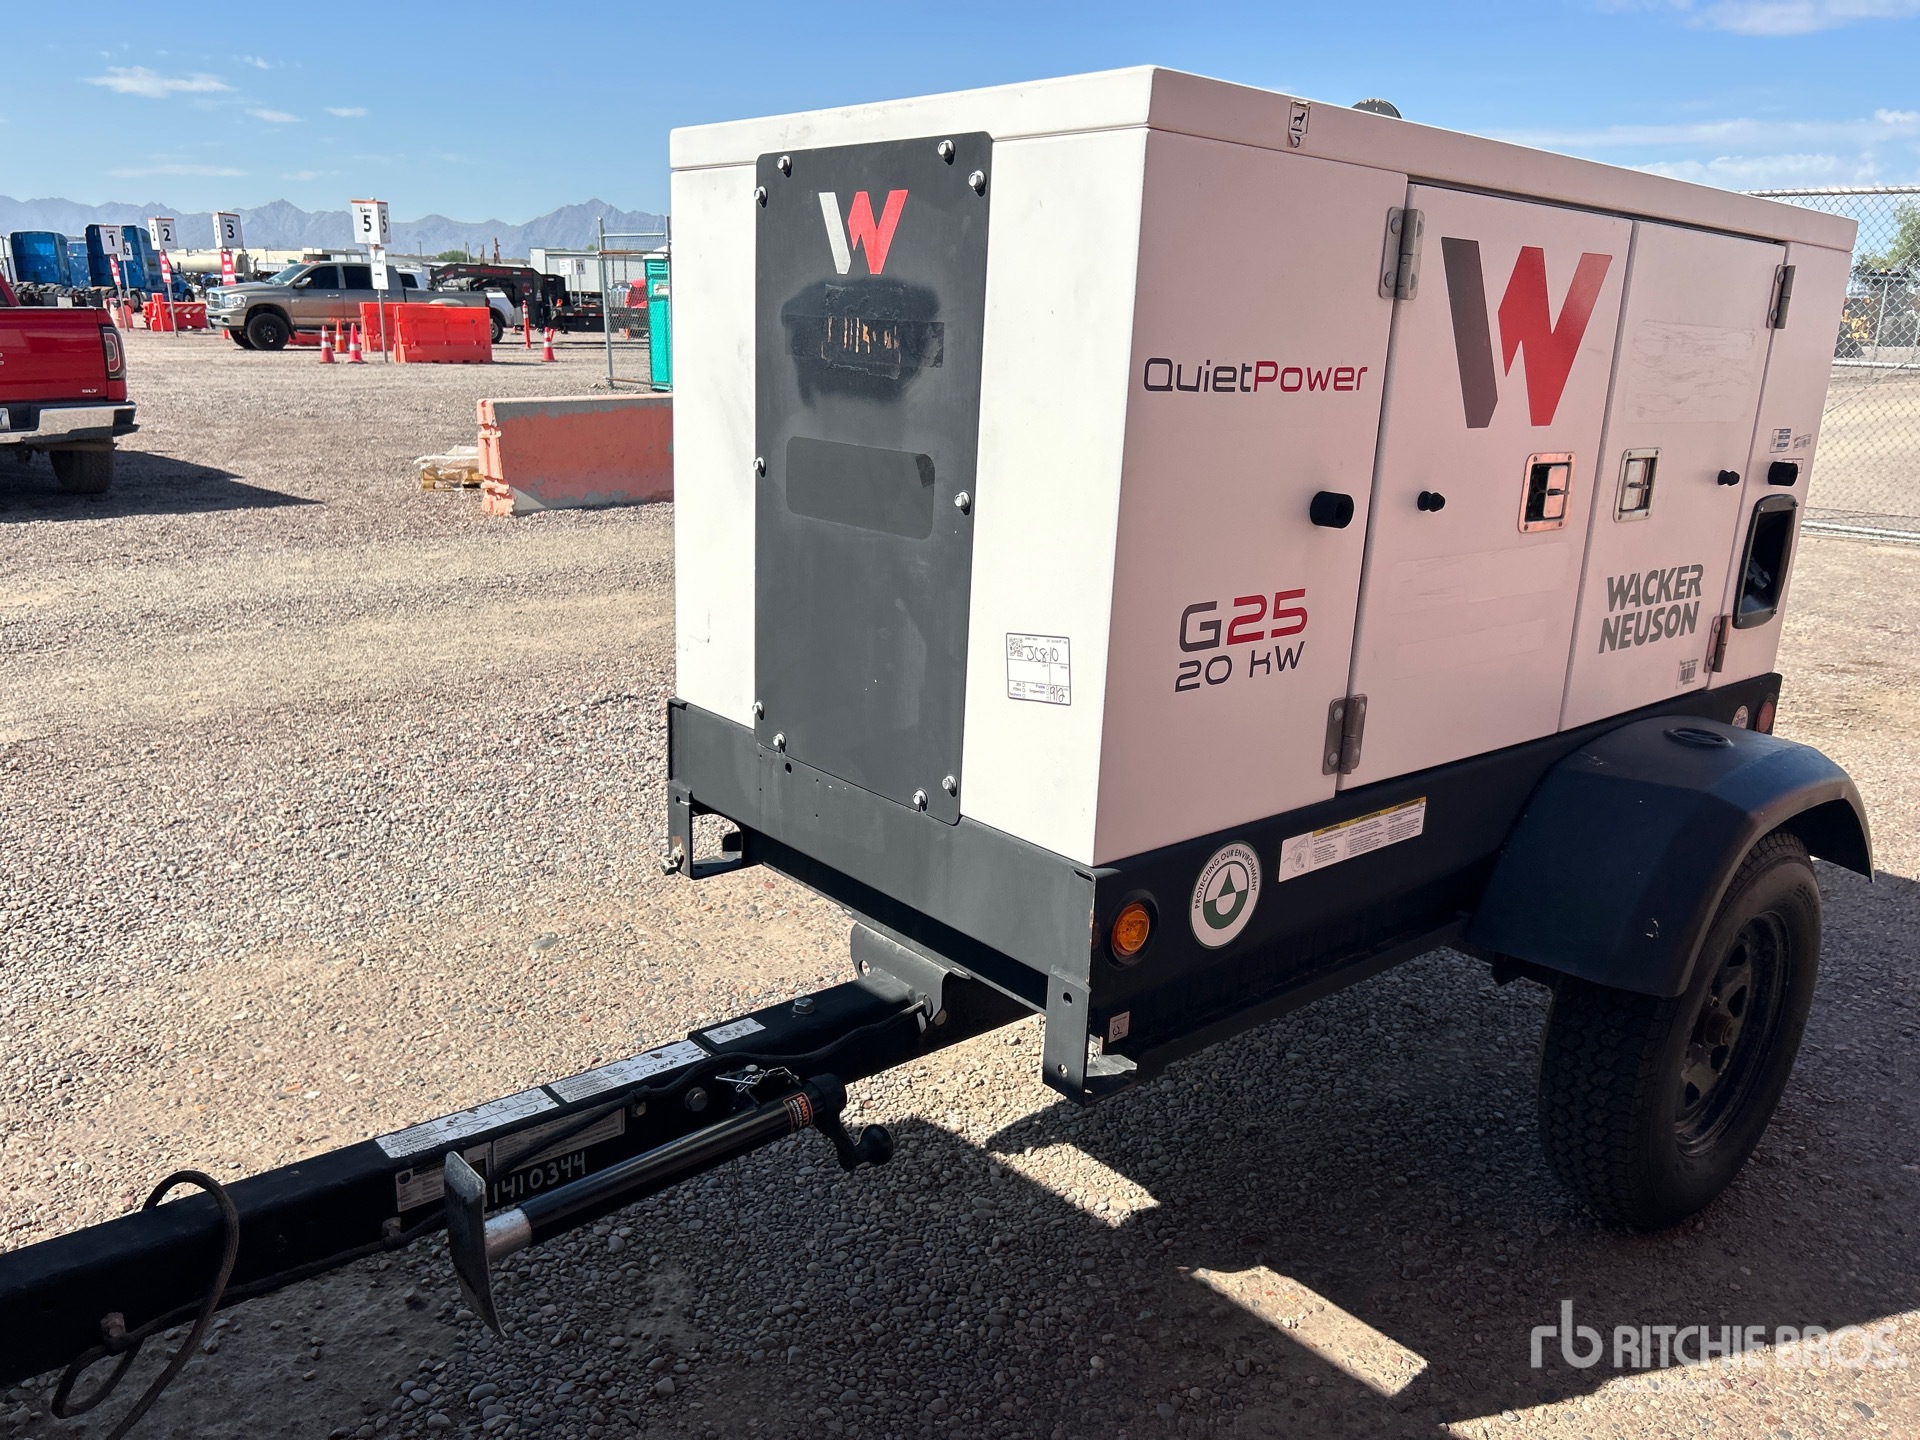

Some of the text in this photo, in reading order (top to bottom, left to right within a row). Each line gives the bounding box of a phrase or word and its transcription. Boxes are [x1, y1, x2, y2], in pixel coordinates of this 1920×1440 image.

[108, 235, 115, 246] 1
[163, 228, 171, 242] 2
[226, 224, 235, 239] 3
[363, 214, 372, 232] 5
[382, 215, 387, 233] 5
[1144, 357, 1368, 393] QuietPower
[1607, 564, 1704, 612] WACKER
[1179, 588, 1308, 652] G25
[1598, 601, 1700, 654] NEUSON
[1175, 655, 1233, 692] 20
[1195, 849, 1257, 909] PROTECTING OUR ENVIRONMENT
[494, 1151, 586, 1204] 1410344
